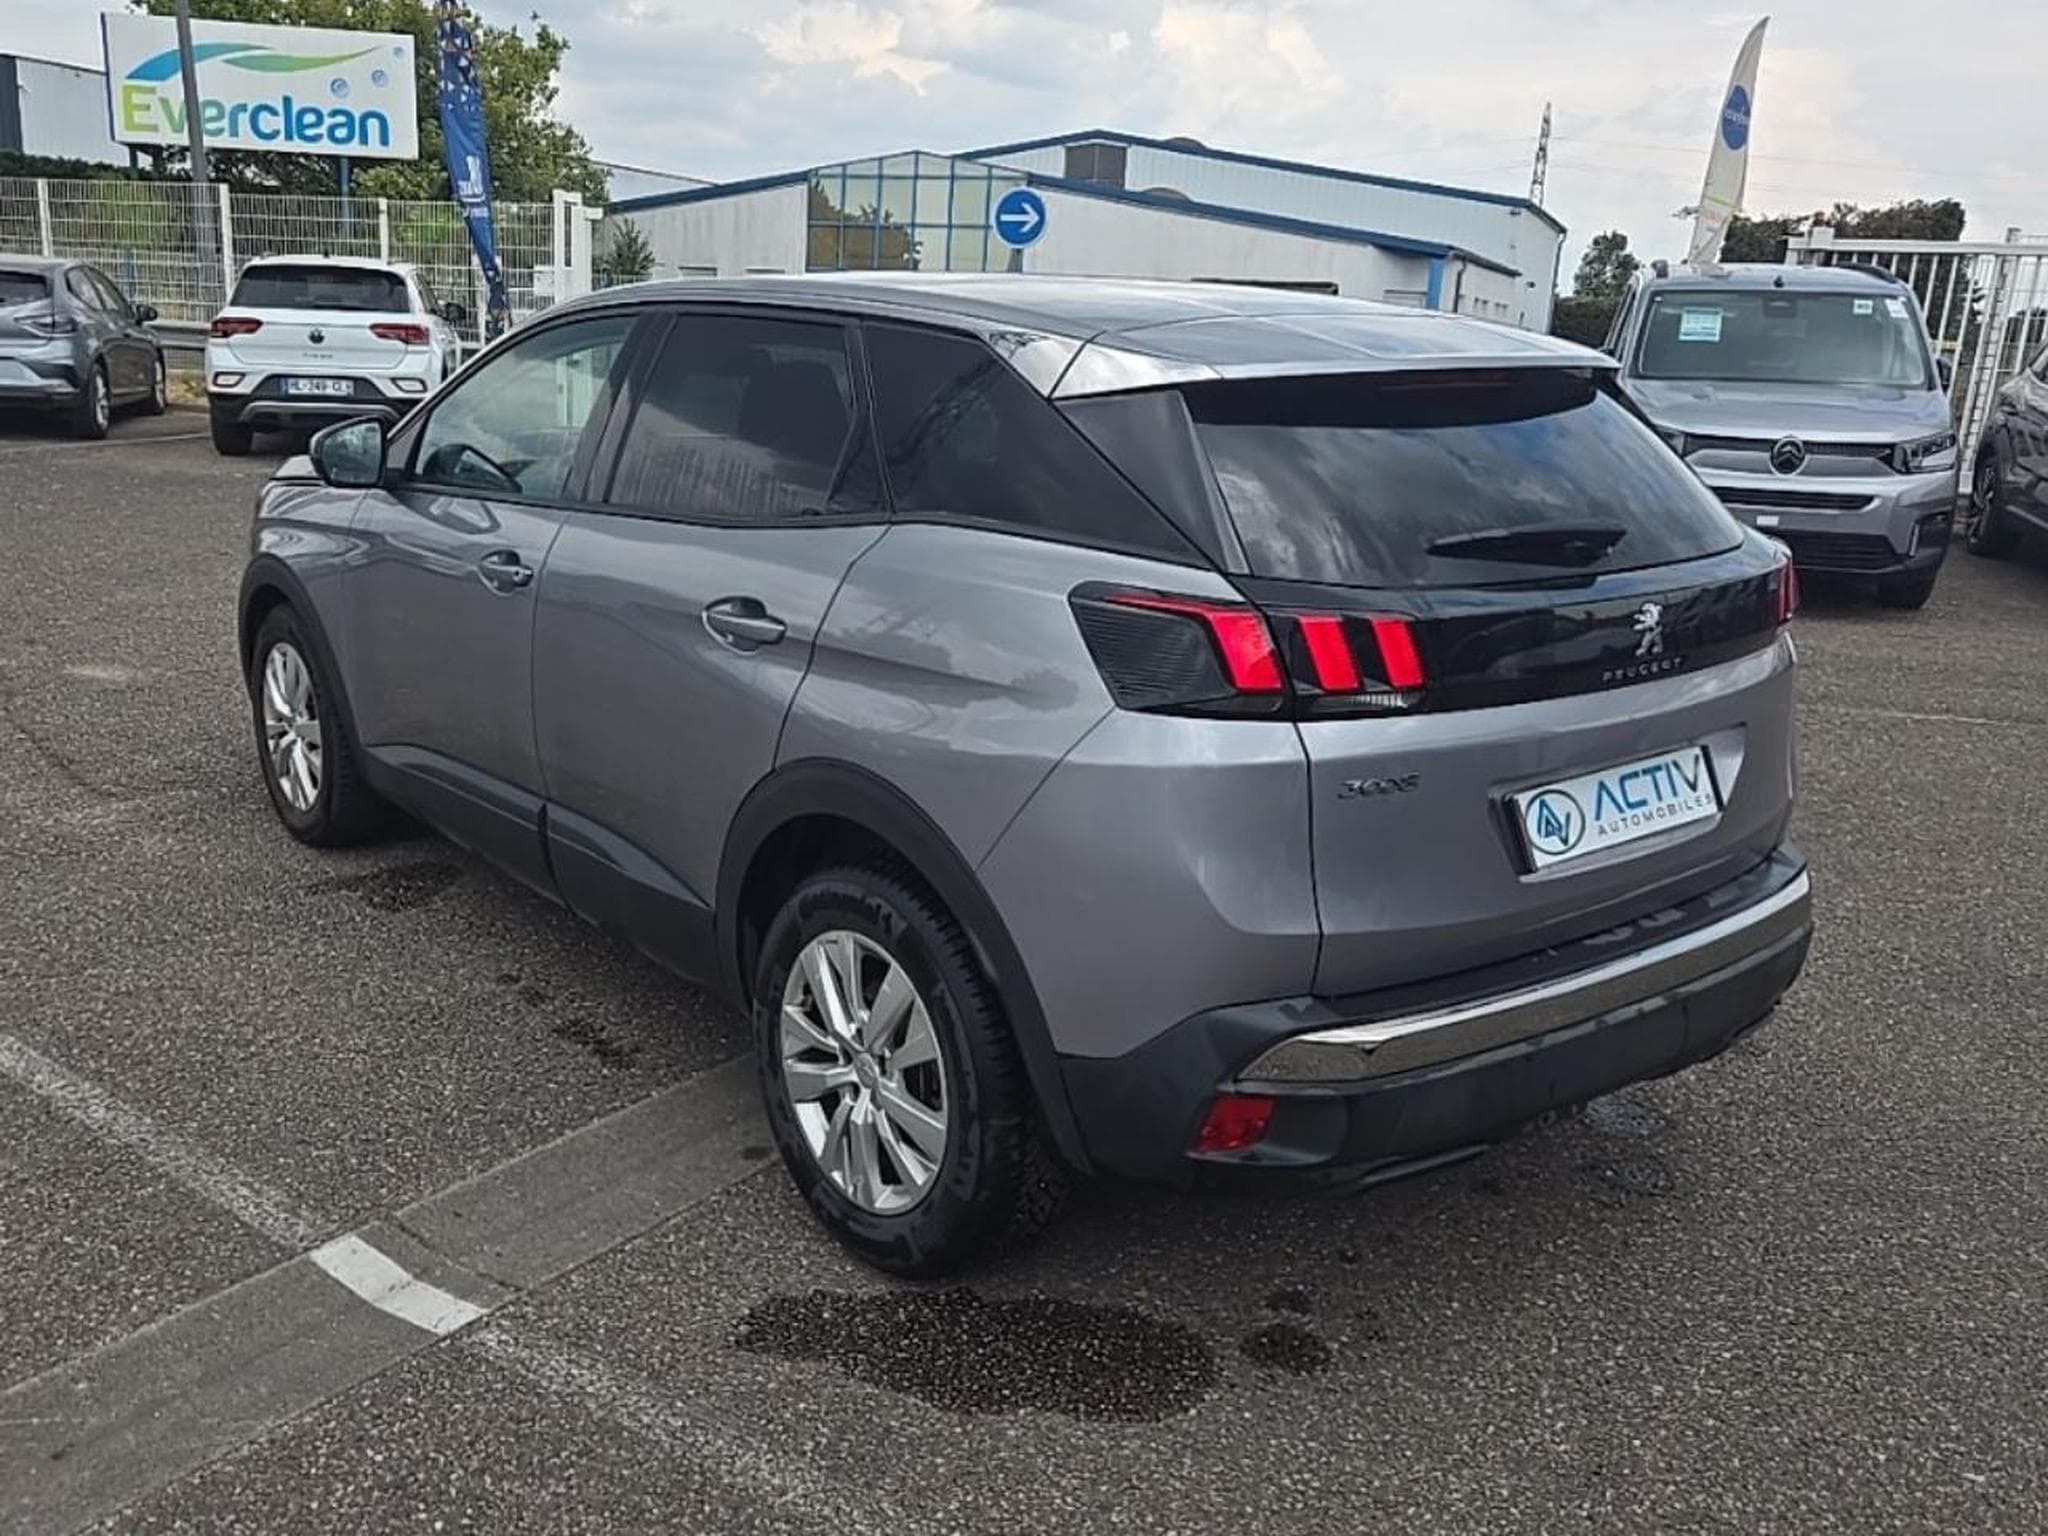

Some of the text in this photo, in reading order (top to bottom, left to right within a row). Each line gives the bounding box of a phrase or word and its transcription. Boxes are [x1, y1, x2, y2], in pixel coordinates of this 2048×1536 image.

[122, 85, 390, 147] Everclean
[1603, 658, 1681, 681] PEUGEOT
[1595, 754, 1700, 822] ACTIV
[1598, 793, 1713, 835] AUTOMOBILES
